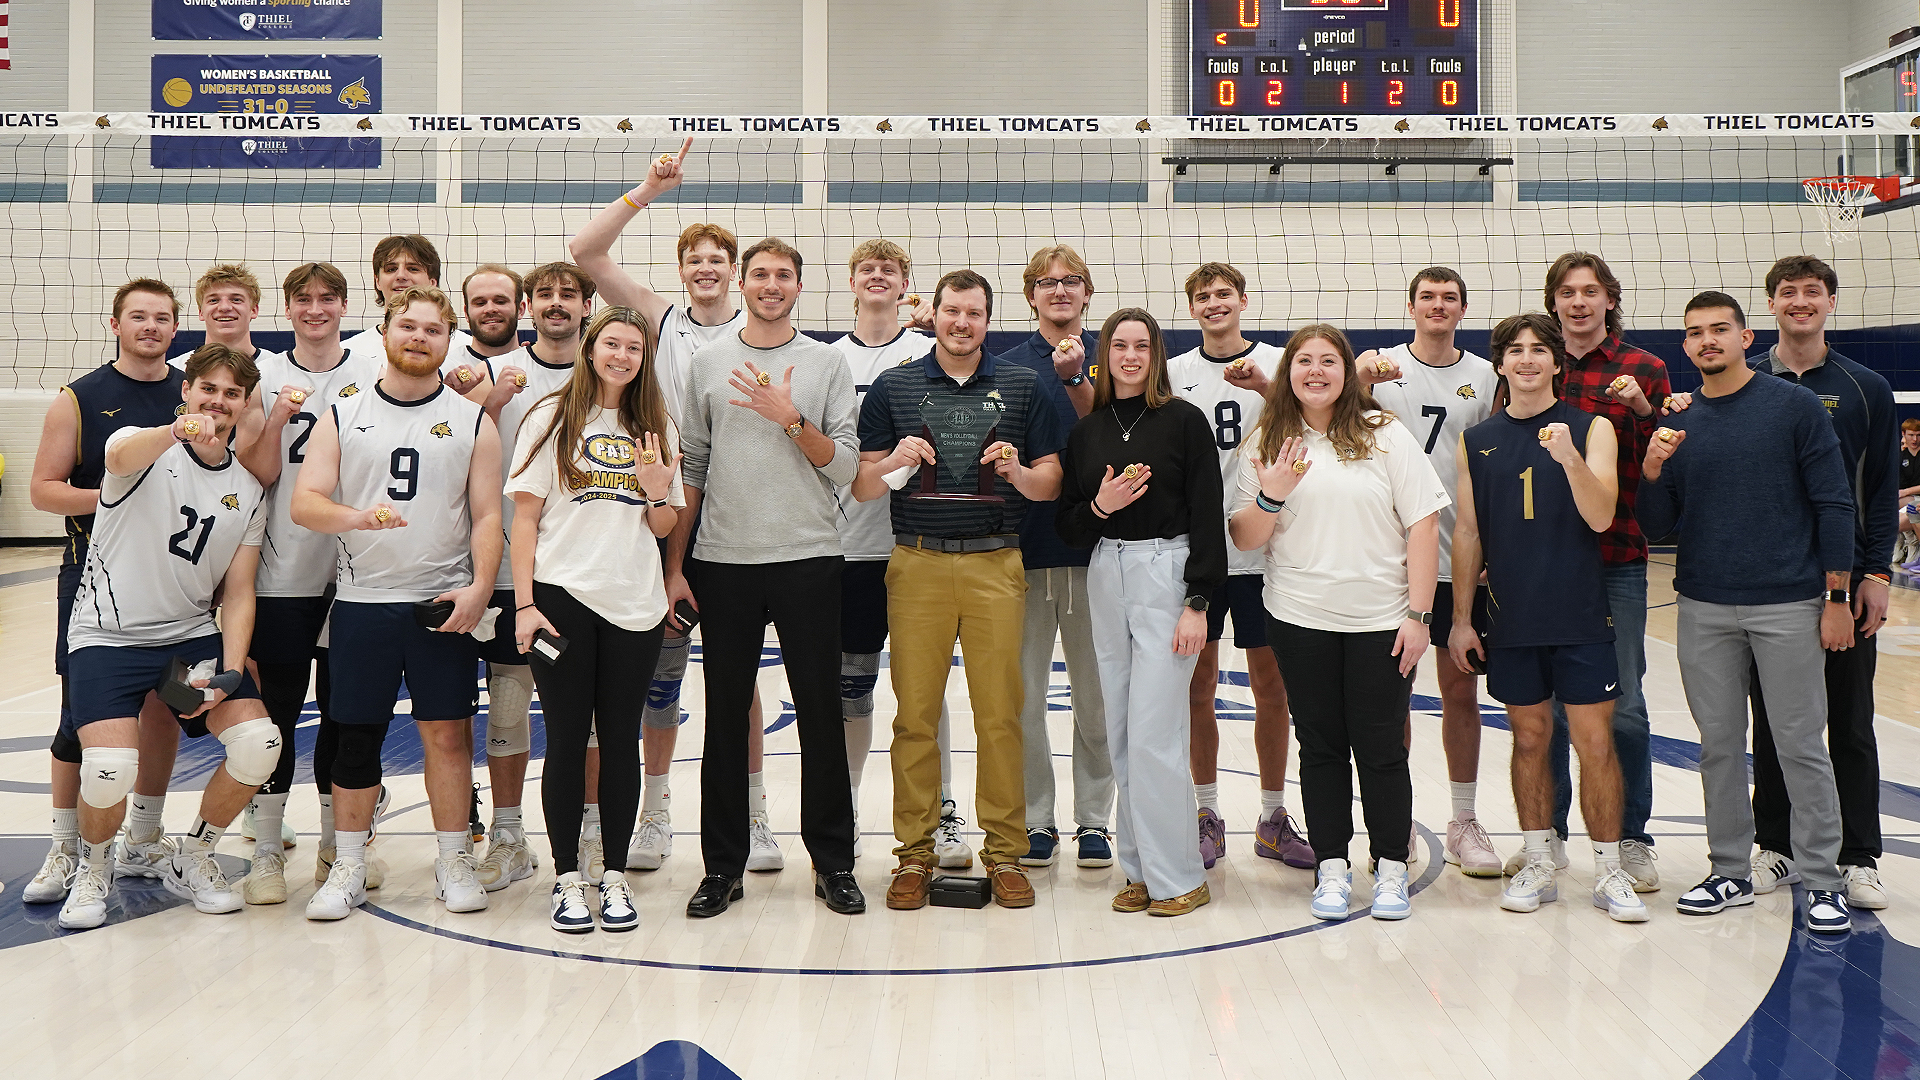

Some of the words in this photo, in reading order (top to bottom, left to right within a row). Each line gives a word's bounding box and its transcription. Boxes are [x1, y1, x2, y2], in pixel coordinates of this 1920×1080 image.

[258, 15, 293, 23] THIEL
[1314, 29, 1355, 46] period
[1208, 59, 1239, 73] fouls
[1314, 57, 1357, 75] player
[1431, 59, 1462, 73] fouls
[201, 70, 257, 80] WOMEN'S
[259, 70, 332, 80] BASKETBALL
[200, 84, 276, 95] UNDEFEATED
[278, 84, 332, 95] SEASONS
[1219, 80, 1234, 105] 0
[1268, 80, 1282, 105] 2
[1342, 81, 1348, 104] 1
[1389, 80, 1403, 105] 2
[1442, 80, 1457, 105] 0
[243, 99, 289, 113] 31-0
[0, 114, 59, 127] CATS
[147, 114, 212, 129] THIEL
[218, 115, 321, 130] TOMCATS
[408, 116, 473, 131] THIEL
[479, 116, 581, 131] TOMCATS
[668, 117, 733, 132] THIEL
[739, 117, 840, 132] TOMCATS
[927, 117, 991, 132] THIEL
[998, 117, 1099, 132] TOMCATS
[1186, 117, 1250, 132] THIEL
[1257, 117, 1358, 132] TOMCATS
[1445, 117, 1509, 132] THIEL
[1515, 117, 1617, 131] TOMCATS
[1703, 115, 1767, 130] THIEL
[1773, 115, 1874, 130] TOMCATS
[257, 141, 289, 149] THIEL
[1214, 400, 1242, 451] 8
[1421, 404, 1448, 455] 7
[595, 442, 631, 459] PAC
[387, 447, 420, 502] 9
[1519, 466, 1535, 520] 1
[168, 504, 216, 566] 21
